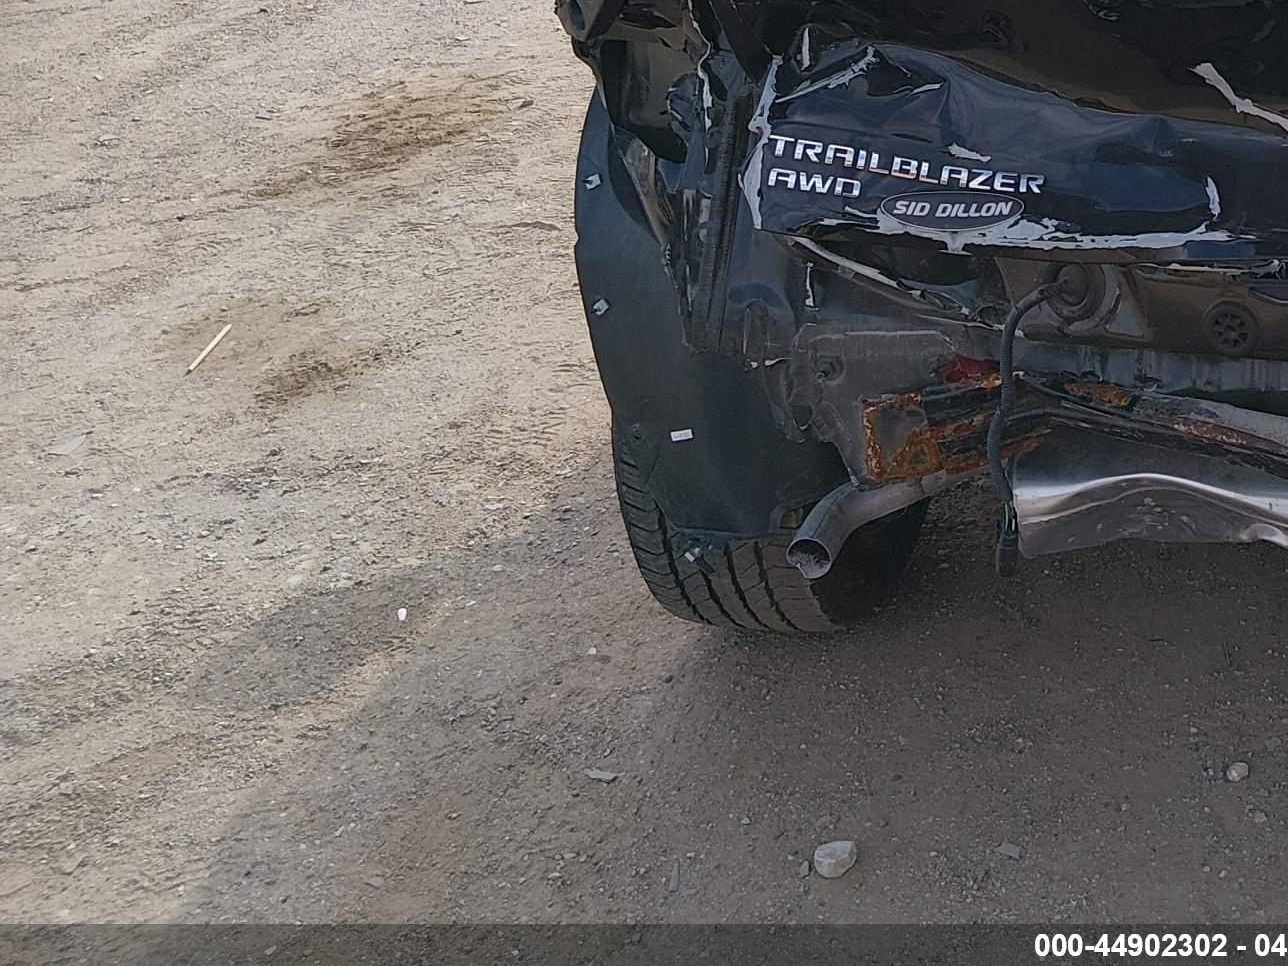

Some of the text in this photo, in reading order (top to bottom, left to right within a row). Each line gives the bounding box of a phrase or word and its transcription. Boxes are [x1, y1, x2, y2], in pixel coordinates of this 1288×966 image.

[768, 134, 1046, 194] TRAILBLAZER
[767, 168, 861, 198] AWD
[893, 200, 1014, 218] SID DILLON
